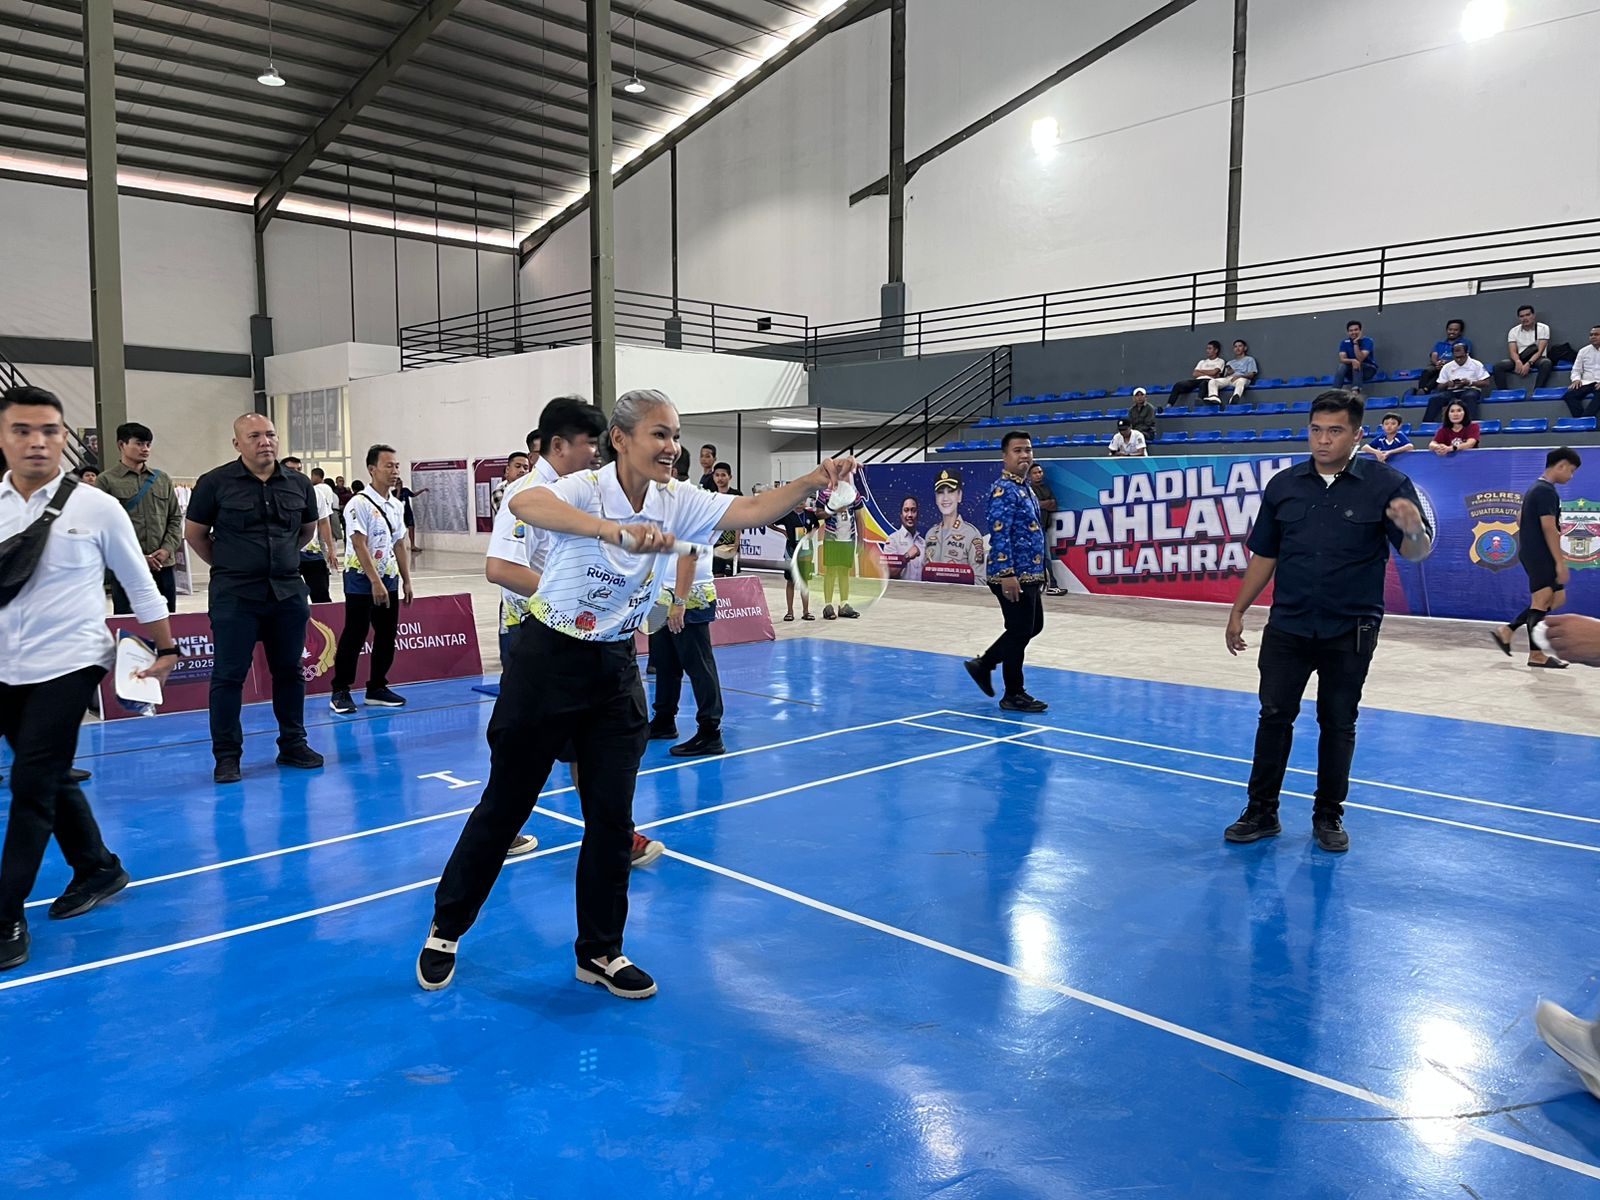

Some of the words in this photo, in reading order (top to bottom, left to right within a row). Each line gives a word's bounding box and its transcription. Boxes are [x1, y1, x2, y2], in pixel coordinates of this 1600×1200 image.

[1099, 457, 1292, 506] JADILAH
[1476, 492, 1521, 500] POLRES
[1470, 508, 1505, 518] SUMATERA
[1050, 494, 1264, 547] PAHLAW
[1088, 542, 1255, 576] OLAHRA
[714, 607, 763, 619] ANGSIANTAR
[188, 659, 214, 669] 2025
